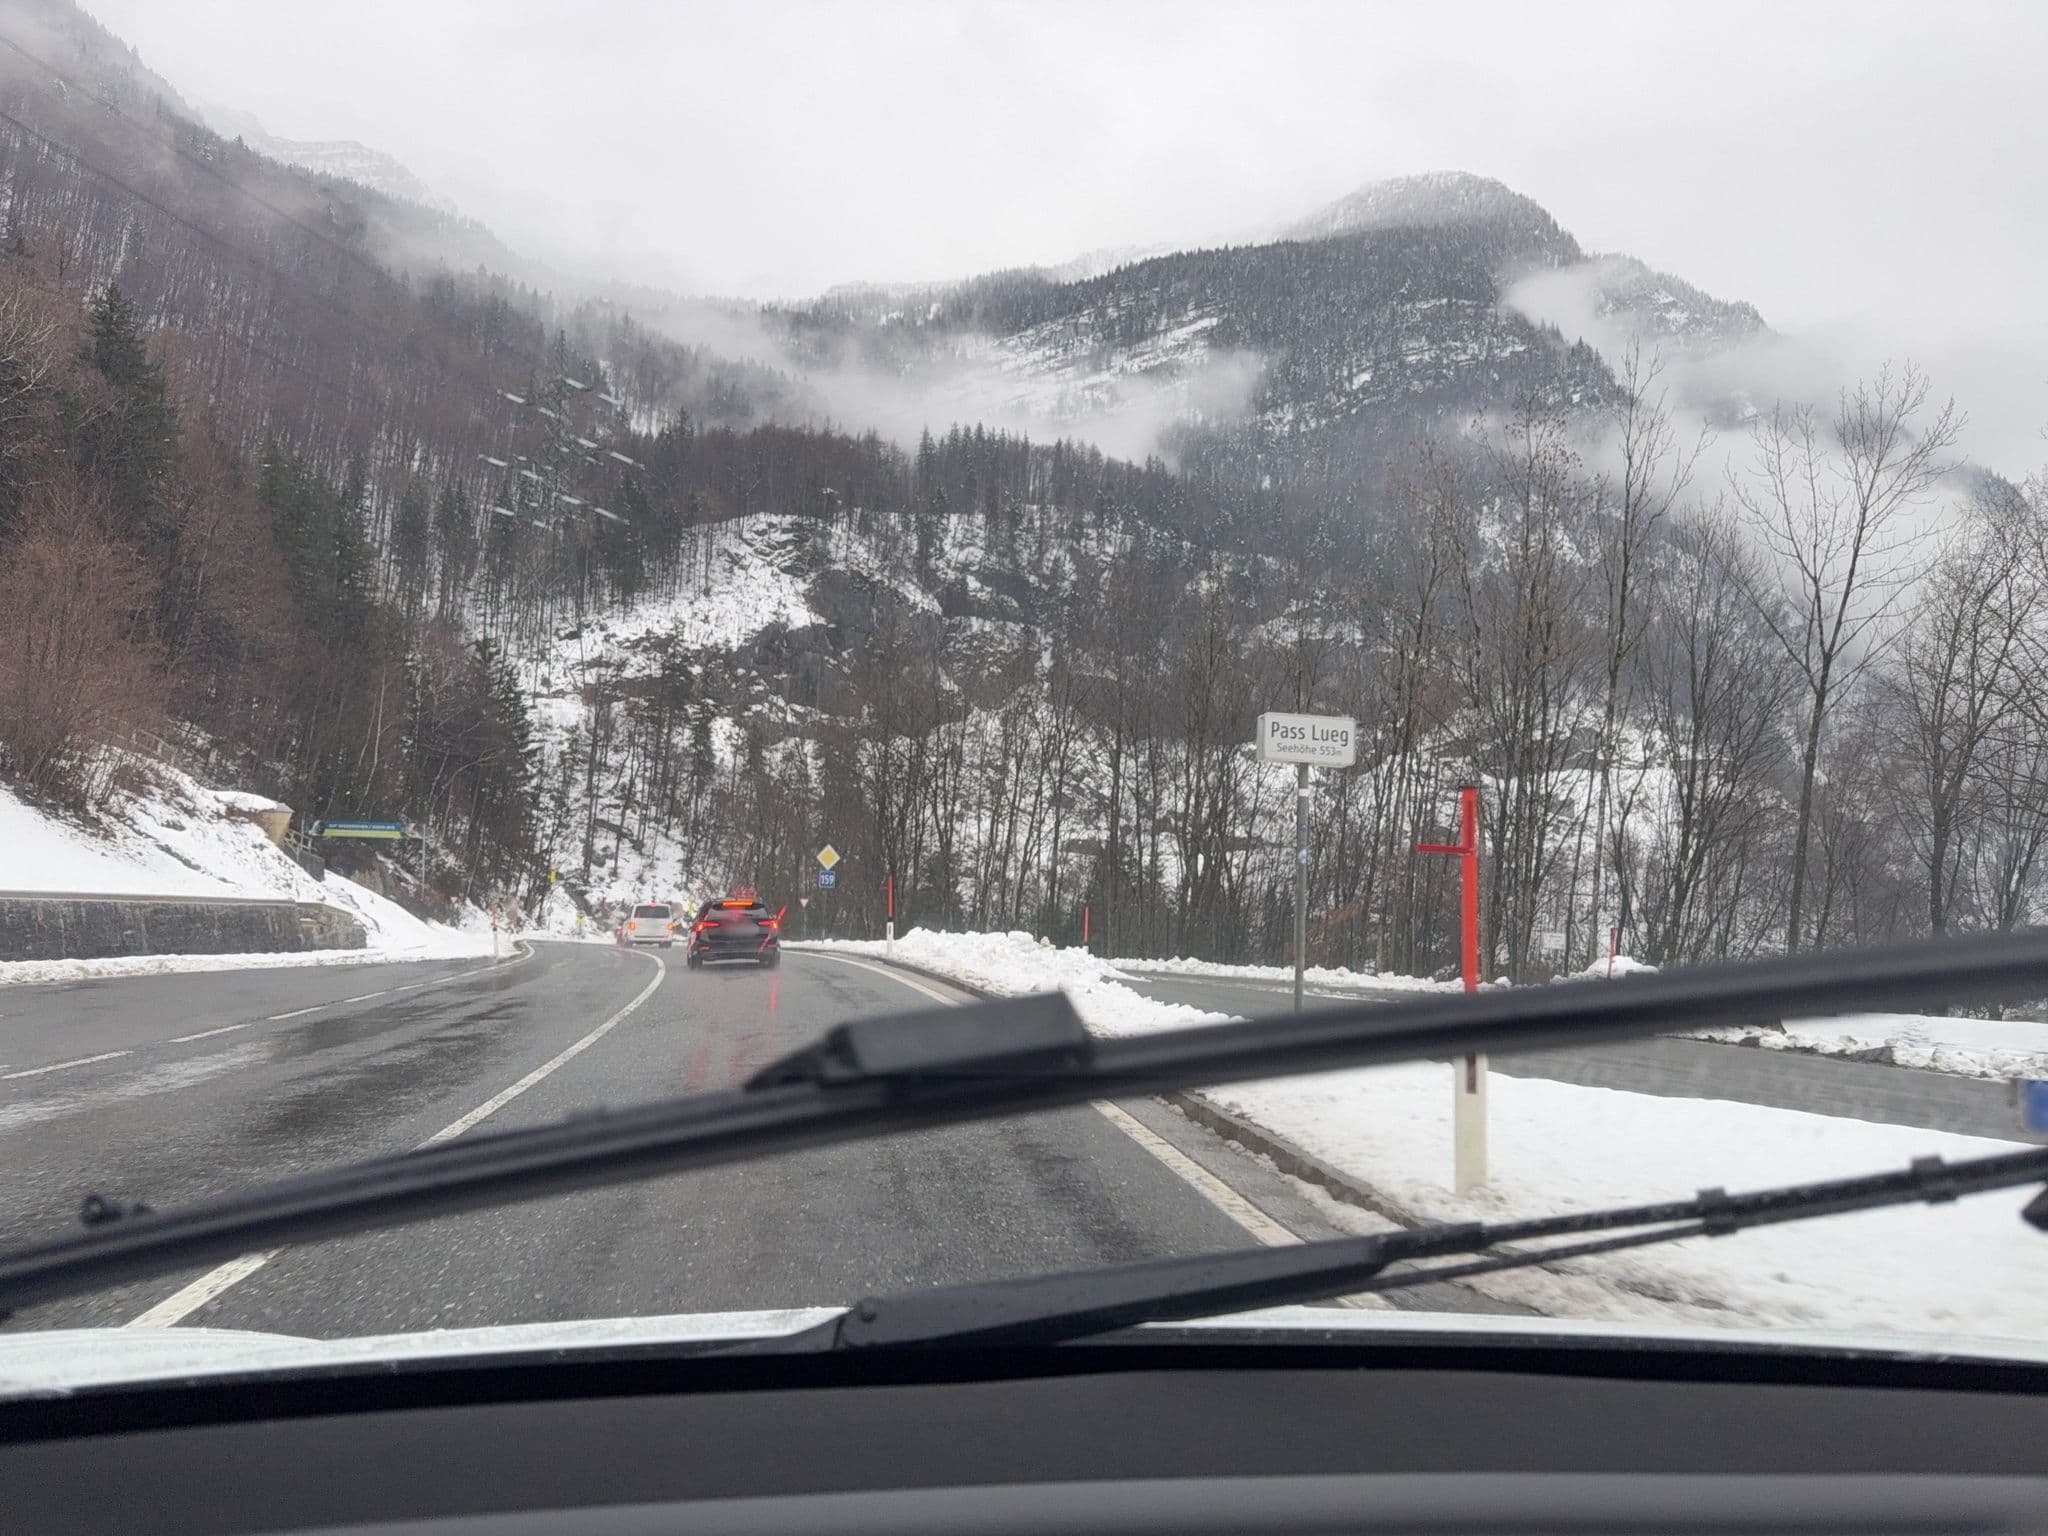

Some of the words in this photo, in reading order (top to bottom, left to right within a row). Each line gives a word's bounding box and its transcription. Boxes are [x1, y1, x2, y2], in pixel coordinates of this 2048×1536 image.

[1271, 721, 1305, 740] Pass
[1312, 724, 1349, 747] Lueg
[1277, 742, 1317, 755] Seehöhe
[821, 874, 834, 885] 159
